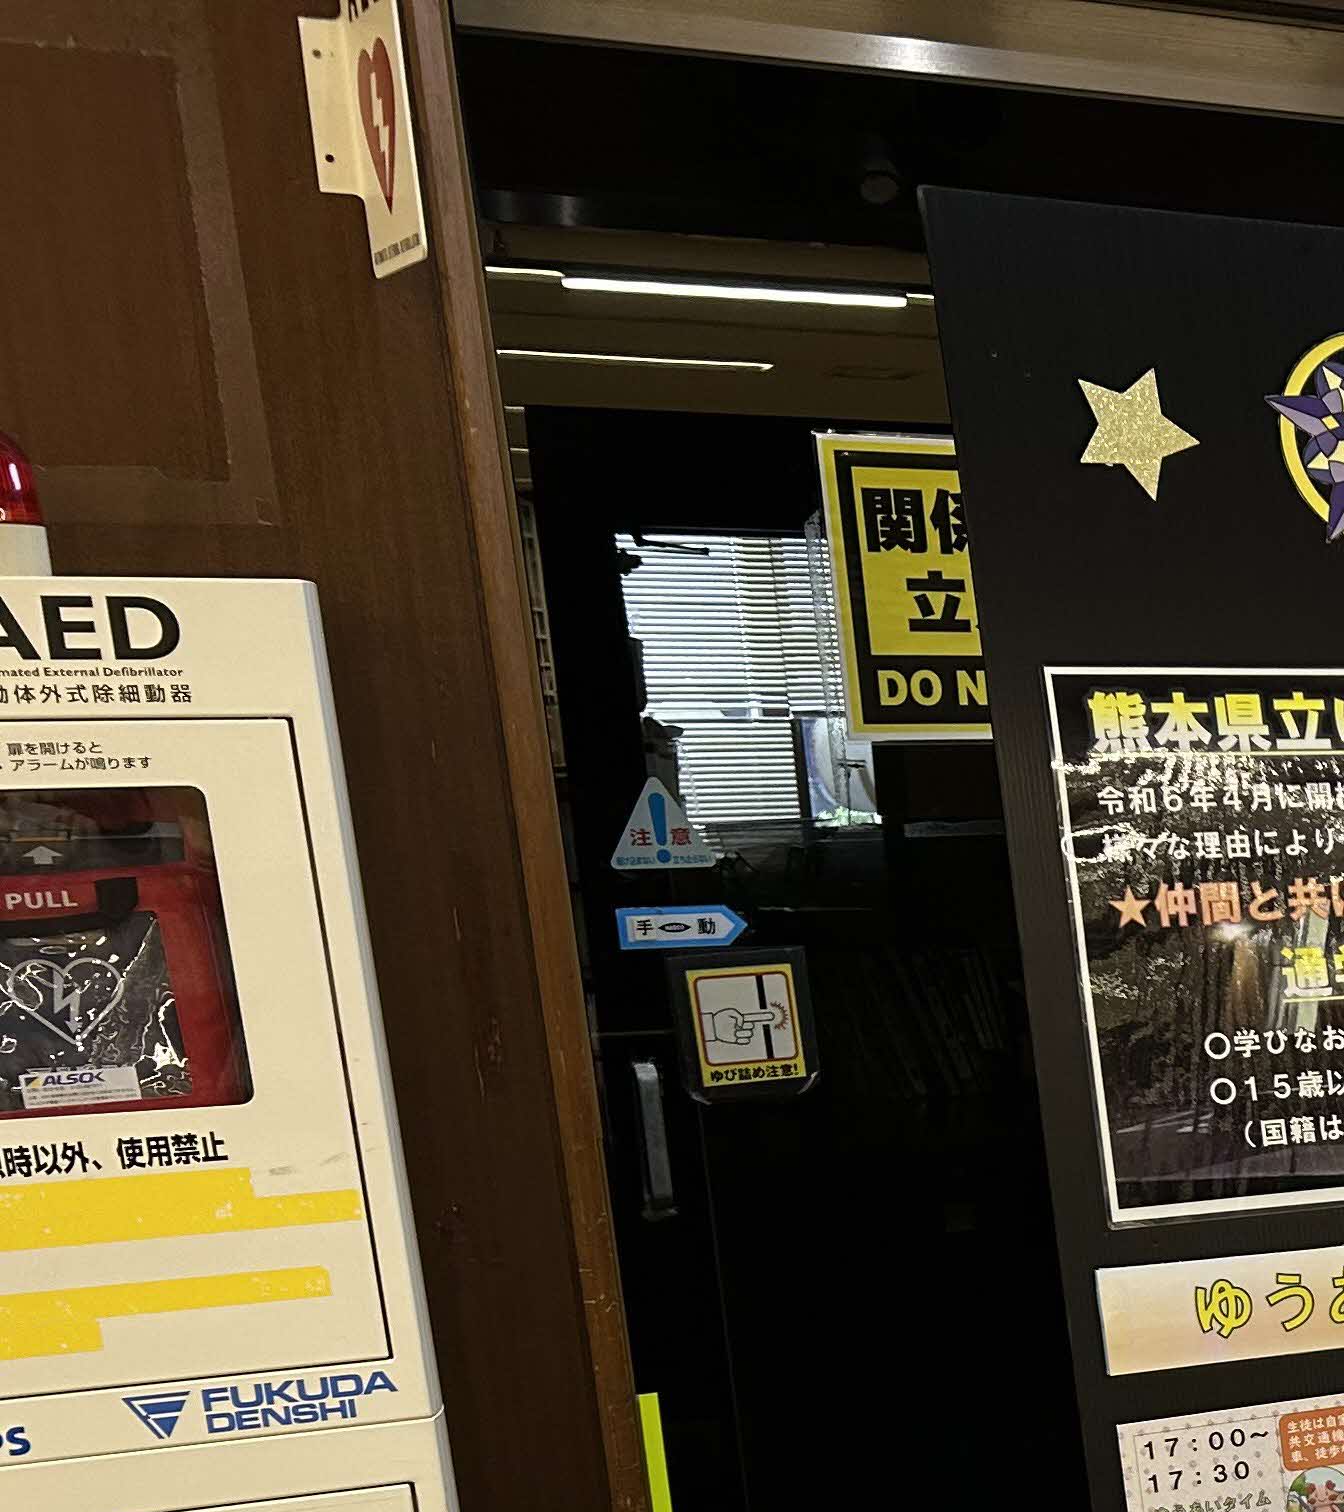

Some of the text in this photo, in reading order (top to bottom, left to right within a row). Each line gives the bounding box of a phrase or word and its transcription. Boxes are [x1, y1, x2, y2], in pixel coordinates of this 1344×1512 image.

[43, 667, 184, 677] External Defibrillator
[878, 669, 942, 707] DO
[7, 742, 104, 756] 扉を開けると
[9, 756, 152, 770] アラームが鳴ります
[5, 890, 79, 911] PULL
[42, 1070, 105, 1087] ALSOK
[201, 1371, 399, 1413] FUKUDA
[205, 1400, 359, 1435] DENSHI
[1148, 1460, 1251, 1494] 17:30
